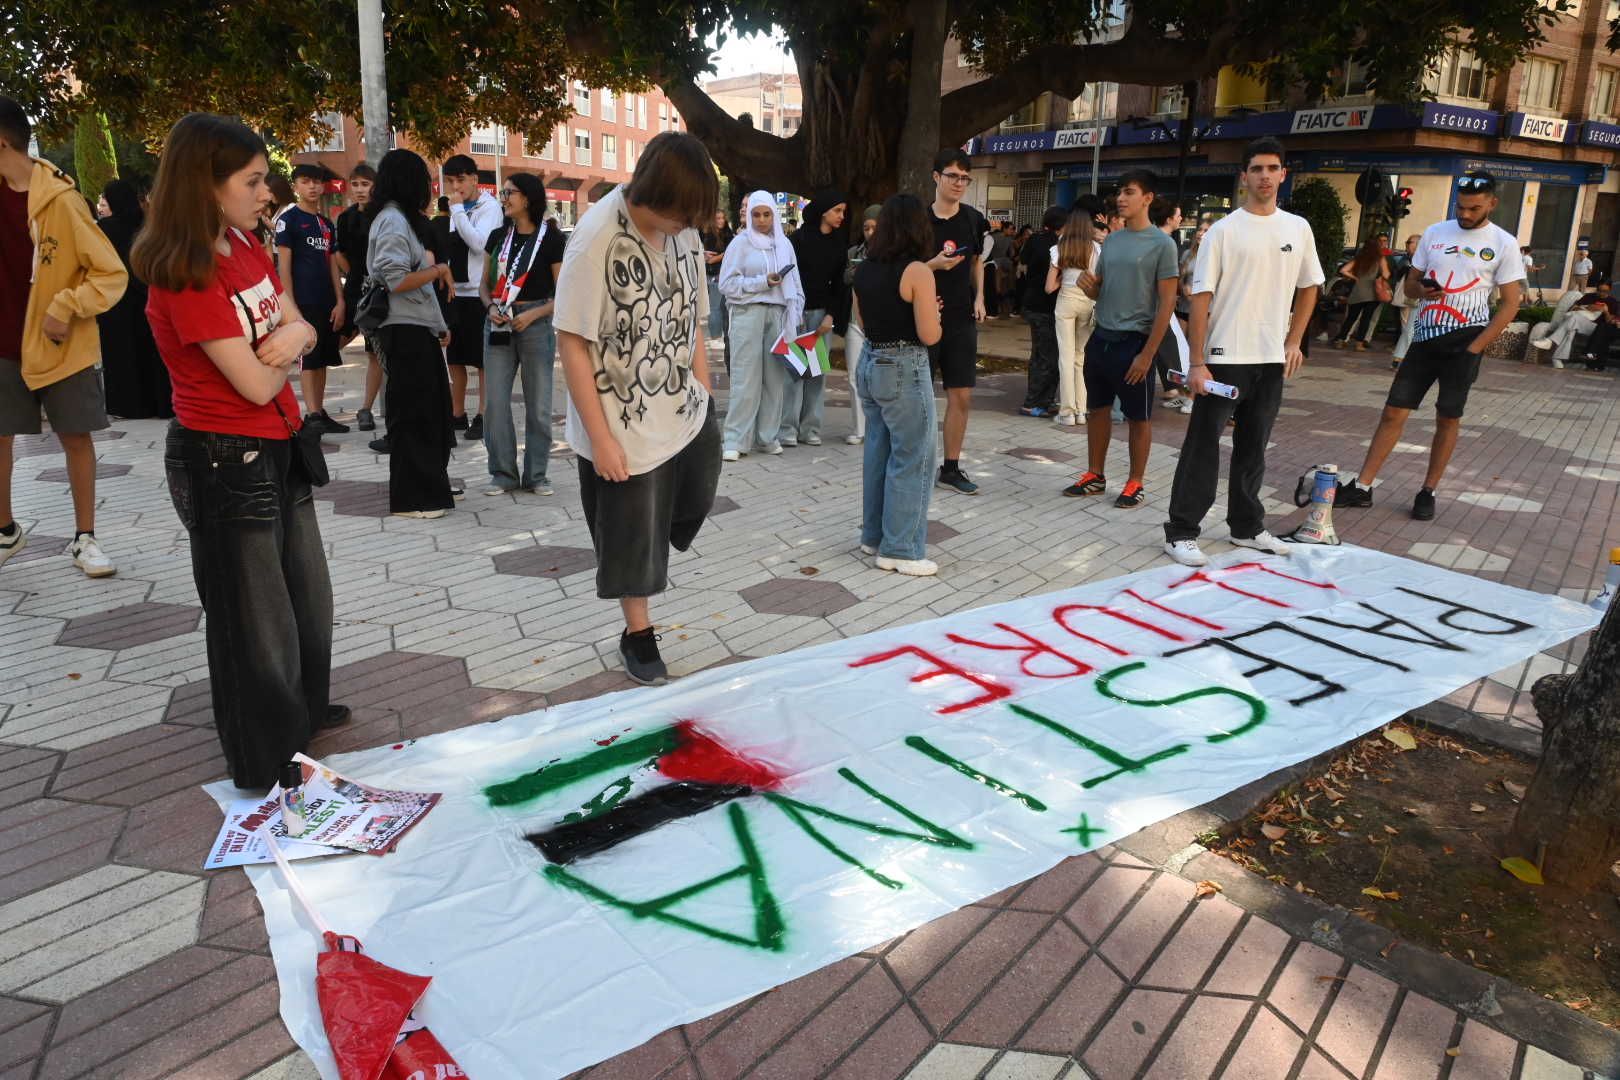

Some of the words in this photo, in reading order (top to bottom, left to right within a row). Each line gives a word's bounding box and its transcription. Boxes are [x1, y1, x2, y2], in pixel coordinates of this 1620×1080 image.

[1296, 110, 1347, 131] FIATC
[1432, 112, 1488, 132] SEGUROS
[1523, 117, 1554, 137] FIATC
[992, 138, 1045, 152] SEGUROS
[1057, 131, 1090, 147] FIATC
[1588, 129, 1620, 145] SEGURO
[542, 586, 1536, 953] PALESTINA
